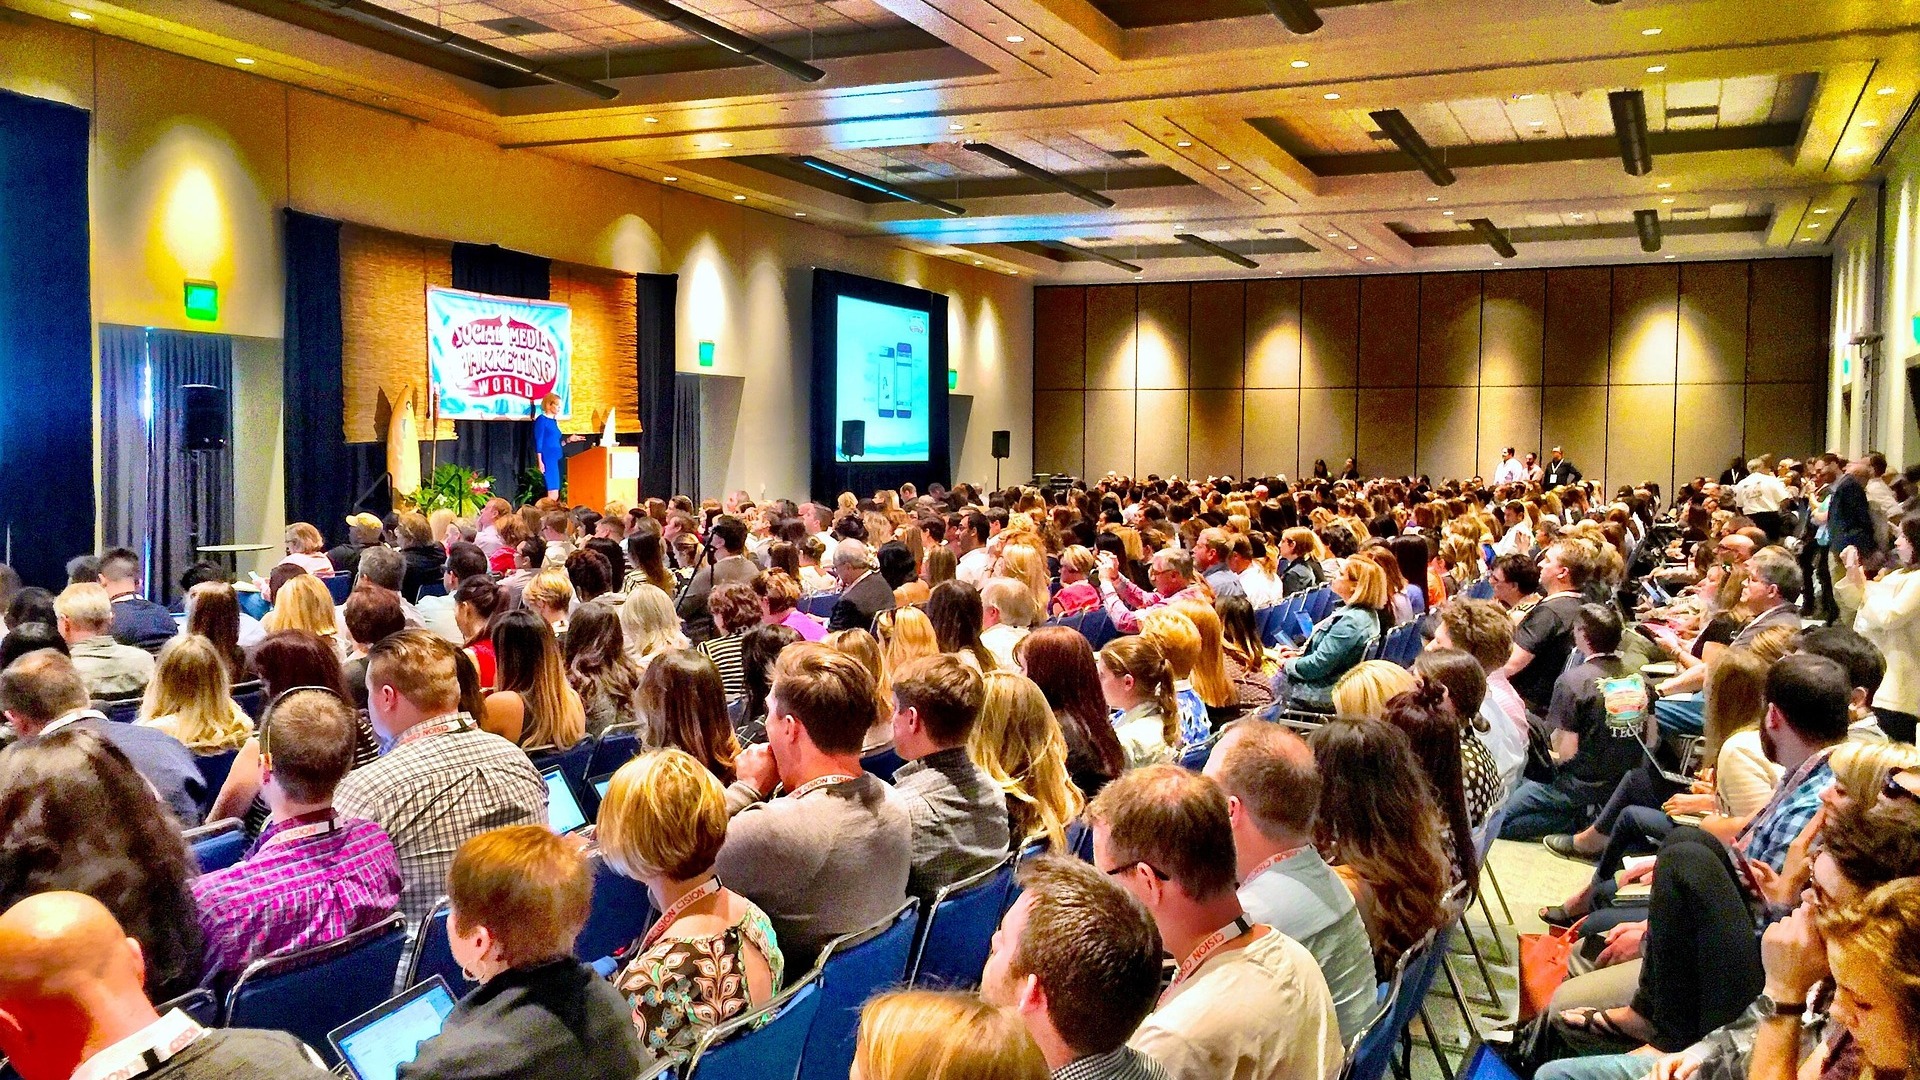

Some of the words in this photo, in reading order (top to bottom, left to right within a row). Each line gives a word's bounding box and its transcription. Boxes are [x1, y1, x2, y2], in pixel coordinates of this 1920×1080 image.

[454, 324, 503, 349] SOCIAL
[508, 326, 552, 356] MEDIA
[477, 377, 534, 398] WORLD
[423, 725, 449, 736] CISION
[1609, 722, 1643, 738] TECH
[284, 826, 316, 839] CISION
[676, 887, 706, 910] CISION
[1192, 932, 1225, 962] CISION
